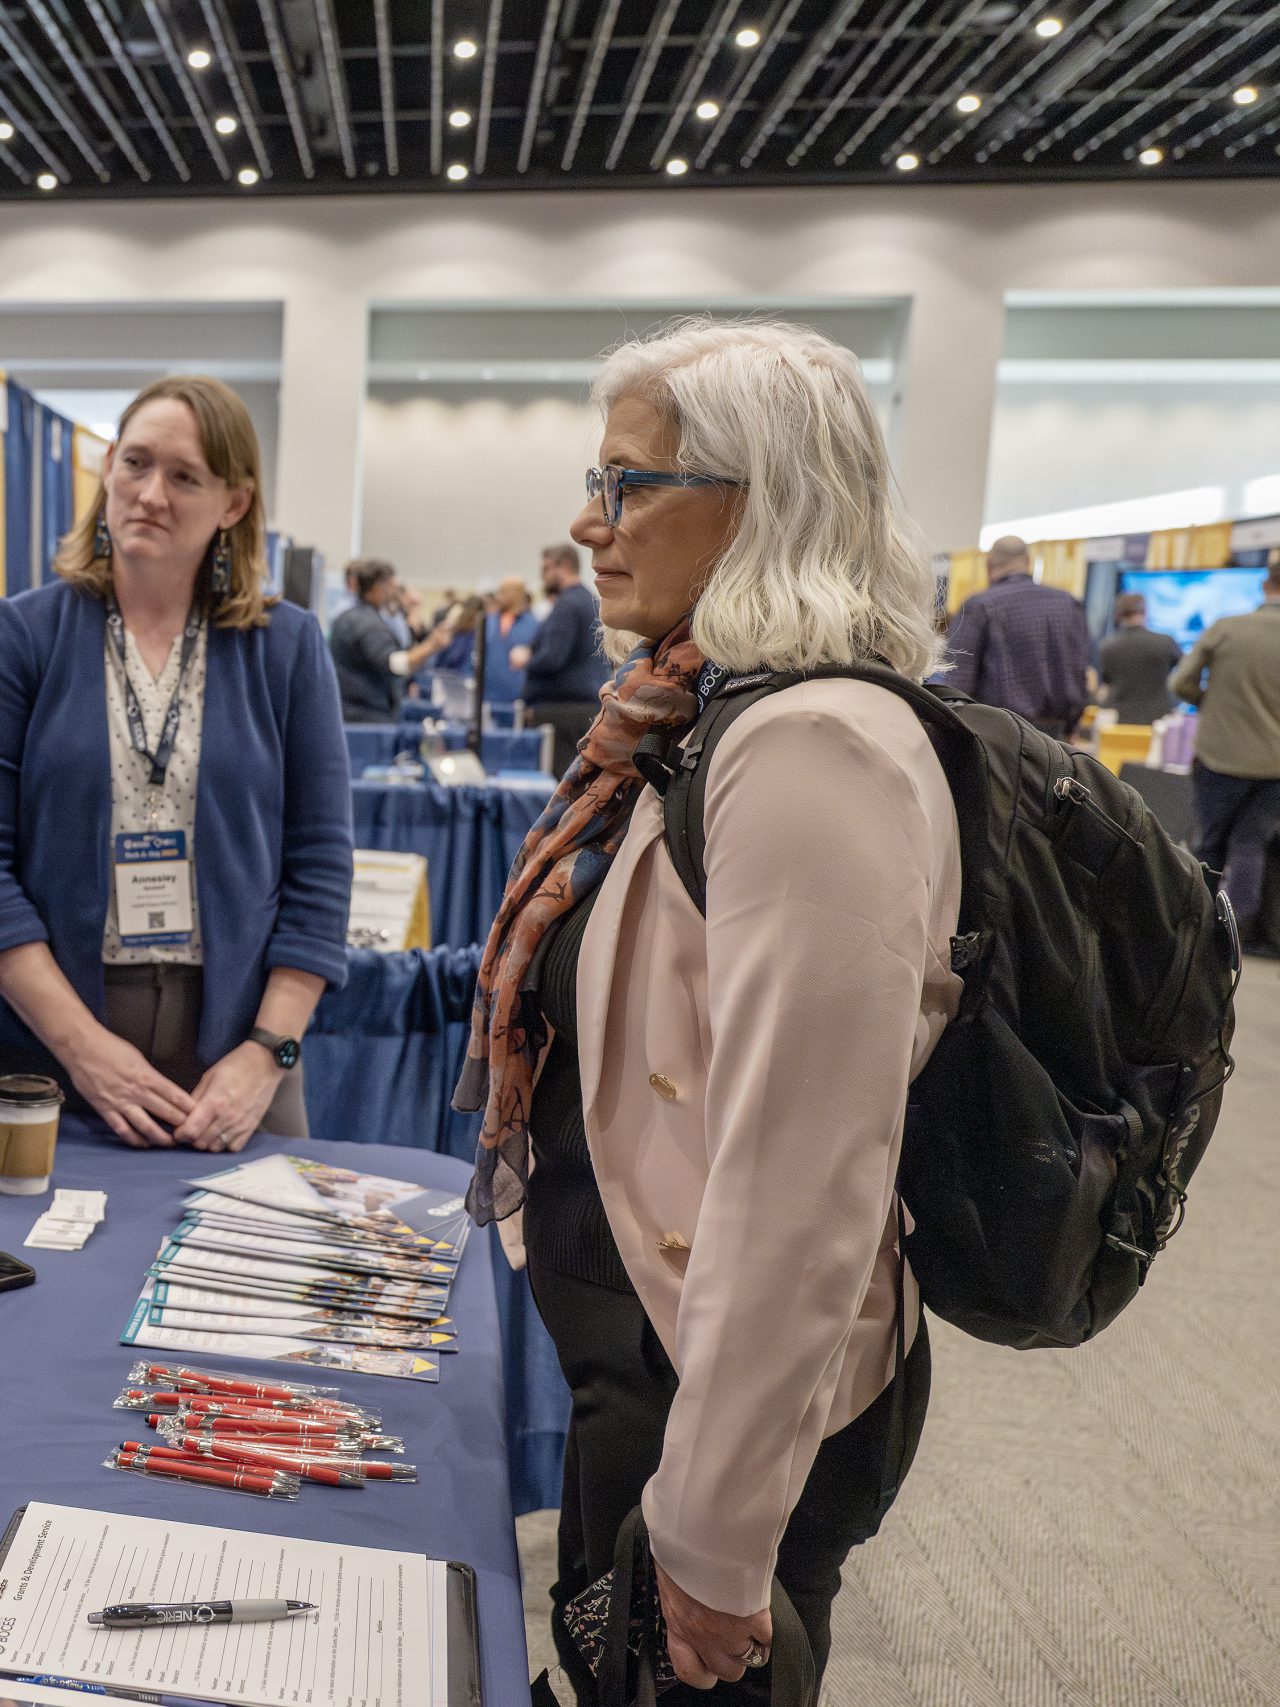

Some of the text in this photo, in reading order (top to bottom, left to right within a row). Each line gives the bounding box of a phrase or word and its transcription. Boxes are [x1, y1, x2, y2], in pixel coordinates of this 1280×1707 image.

[13, 1583, 28, 1601] Grants
[23, 1539, 45, 1574] Development
[38, 1520, 52, 1538] Service
[156, 1610, 193, 1623] NERIC
